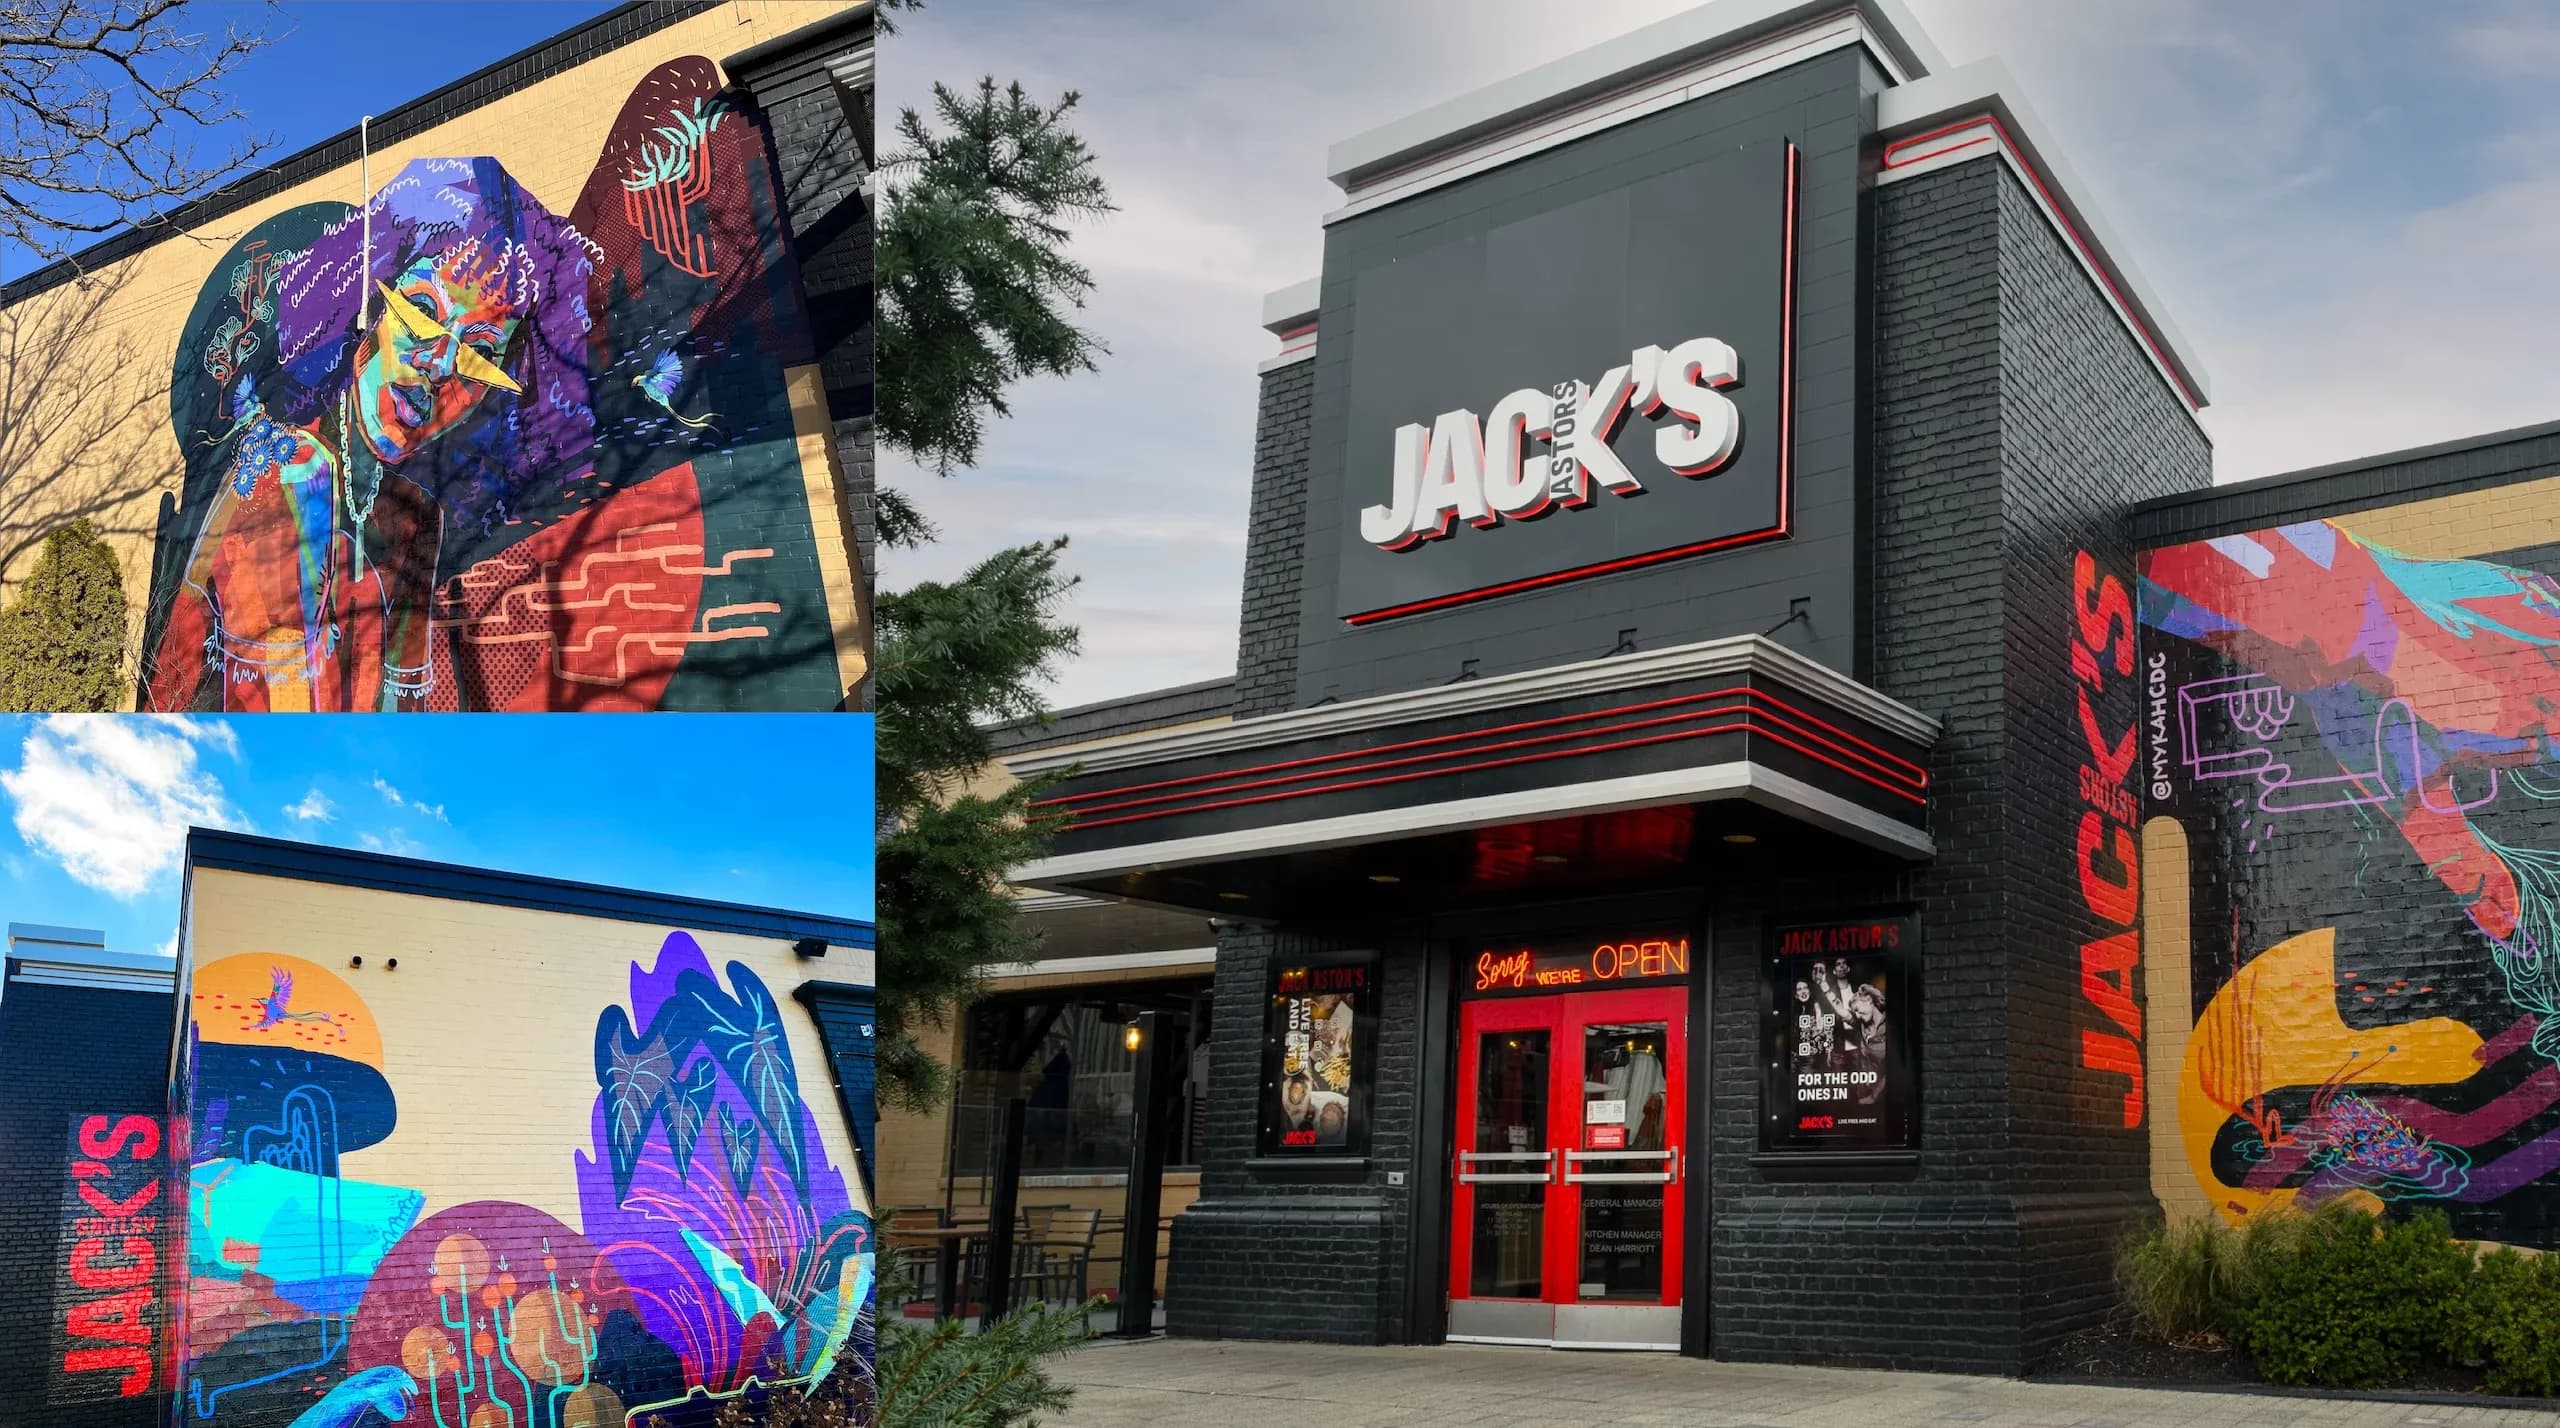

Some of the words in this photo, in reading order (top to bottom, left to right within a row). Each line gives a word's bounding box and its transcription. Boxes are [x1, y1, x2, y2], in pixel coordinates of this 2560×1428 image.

[1360, 336, 1740, 548] JACK'S
[1551, 379, 1577, 497] ASTORS
[2147, 651, 2173, 801] @MYKAHCDC
[2071, 549, 2144, 1129] JACK'S
[1780, 929, 1824, 955] JACK
[1828, 923, 1900, 952] ASTOR'S
[1476, 951, 1531, 991] Sorry
[1535, 968, 1582, 986] WE'RE
[1592, 939, 1688, 980] OPEN
[1288, 998, 1300, 1031] AND
[1300, 998, 1312, 1031] LIVE
[1798, 1073, 1822, 1087] FOR
[1825, 1072, 1849, 1086] THE
[1850, 1071, 1877, 1085] ODD
[1798, 1088, 1831, 1102] ONES
[1833, 1087, 1848, 1101] IN
[1282, 1129, 1317, 1145] JACK'S
[1799, 1114, 1833, 1129] JACK'S
[1583, 1198, 1622, 1208] GENERAL
[1623, 1198, 1664, 1208] MANAGER
[1584, 1230, 1620, 1239] KITCHEN
[1620, 1230, 1662, 1240] MANAGER
[1589, 1244, 1613, 1253] DEAN
[63, 1114, 161, 1398] JACK'S
